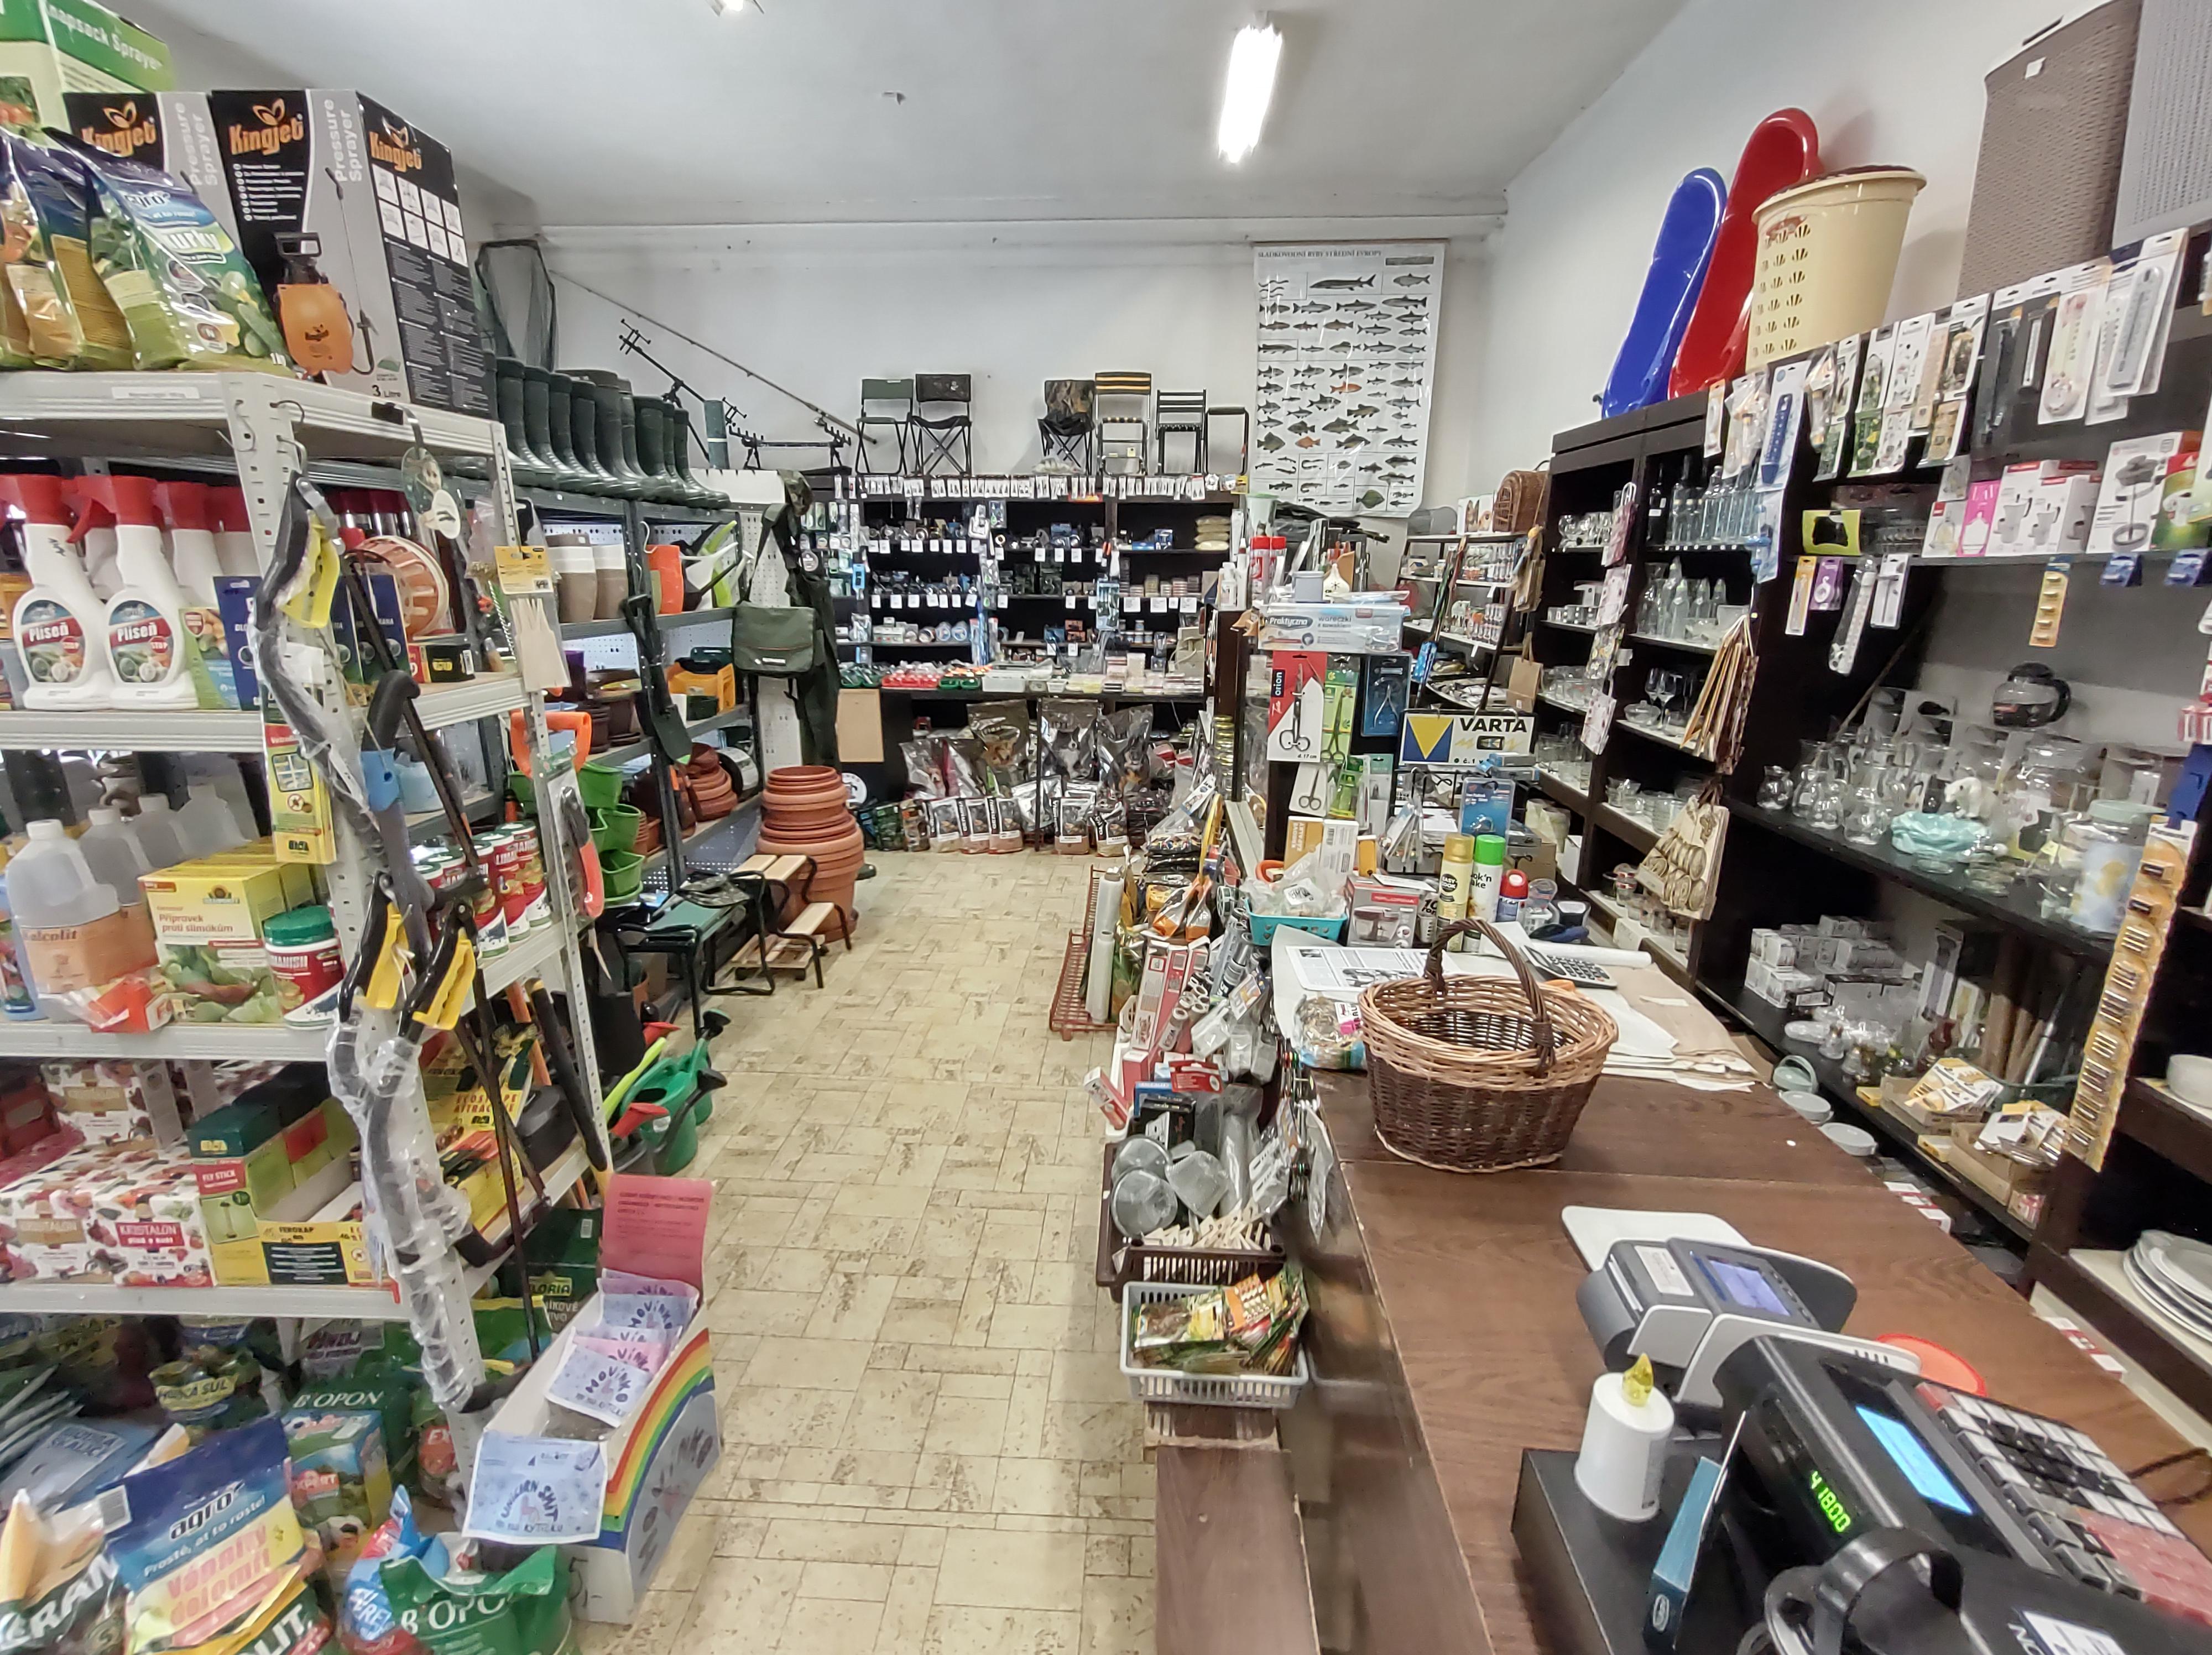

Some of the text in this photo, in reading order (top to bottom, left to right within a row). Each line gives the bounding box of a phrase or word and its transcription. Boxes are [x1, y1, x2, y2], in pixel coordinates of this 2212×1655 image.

[175, 102, 204, 186] Pressure
[228, 116, 304, 155] Kingjet
[324, 98, 348, 183] Pressure
[192, 113, 218, 186] Sprayer
[340, 109, 363, 182] Sprayer
[369, 131, 422, 173] Kingjet
[372, 384, 382, 398] 3
[1269, 617, 1308, 627] Praktyczna
[1273, 671, 1283, 696] orion
[1460, 717, 1527, 733] VARTA
[1471, 880, 1486, 889] ake
[162, 924, 182, 933] proti
[202, 1169, 236, 1182] FLY STICK
[119, 1224, 177, 1236] KRISTALON
[529, 1283, 571, 1296] LORIA
[292, 1390, 385, 1409] BOPON
[169, 1490, 233, 1542] agro
